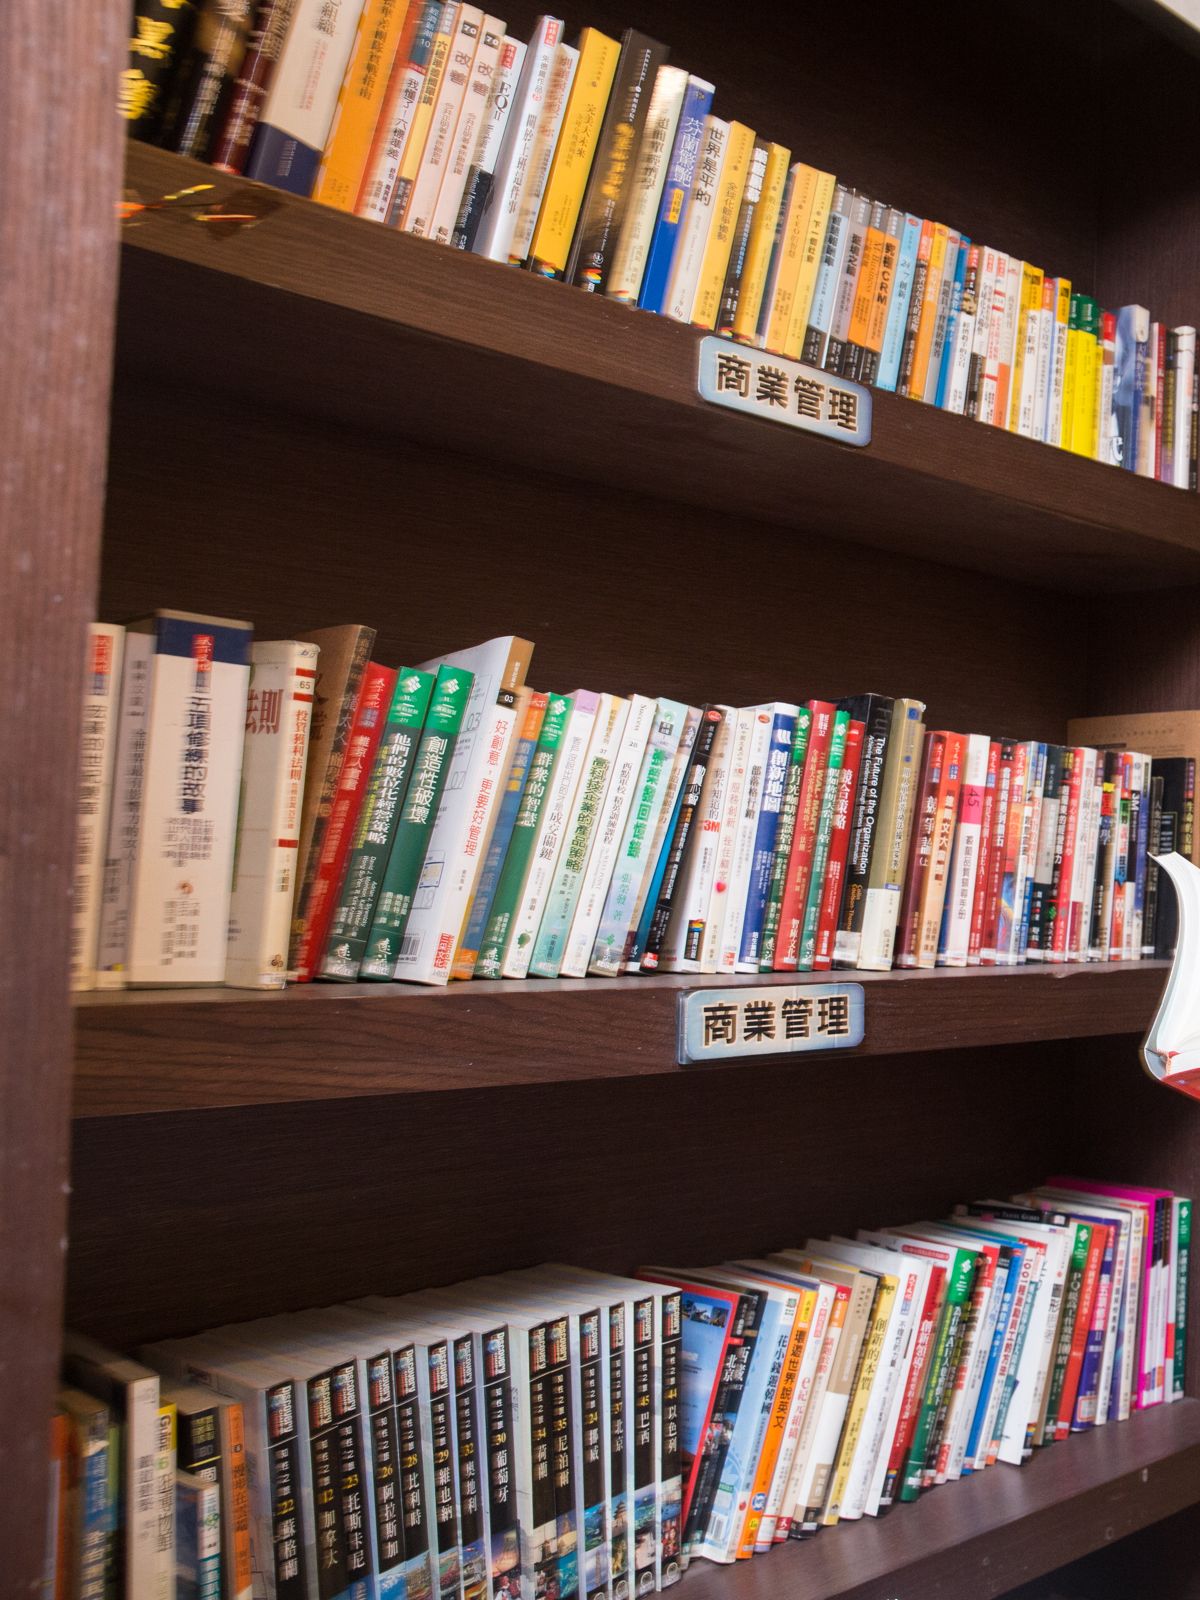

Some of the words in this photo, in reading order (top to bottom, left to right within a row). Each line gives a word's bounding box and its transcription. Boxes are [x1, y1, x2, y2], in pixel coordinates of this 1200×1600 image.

[494, 81, 512, 112] EQ
[508, 113, 538, 214] 關於上班這件事
[673, 116, 704, 190] 芬蘭驚豔
[696, 126, 724, 206] 世界是平的
[716, 352, 859, 433] 商業管理
[504, 694, 514, 703] 03
[180, 695, 210, 815] 五項修練的故事
[870, 755, 884, 788] Future
[874, 737, 886, 756] The
[408, 735, 449, 825] 創造性破壞
[518, 752, 553, 828] 群眾的智慧
[709, 767, 727, 819] 你不知道的
[762, 750, 788, 813] 創新地圖
[834, 767, 855, 831] 競合策略
[703, 819, 721, 833] 3M
[859, 815, 876, 876] Organization
[703, 995, 849, 1047] 商業管理
[723, 1354, 738, 1382] 北京
[861, 1318, 887, 1391] 創新的本質
[614, 1418, 624, 1453] 北京
[639, 1411, 650, 1446] 巴西
[667, 1404, 678, 1455] 以色列
[406, 1471, 422, 1527] 比利時
[438, 1466, 453, 1523] 維也納
[495, 1449, 509, 1504] 葡萄牙
[280, 1517, 298, 1581] 蘇格蘭
[321, 1510, 338, 1570] 加拿大
[347, 1491, 366, 1571] 托斯卡尼
[380, 1482, 399, 1559] 阿拉斯加
